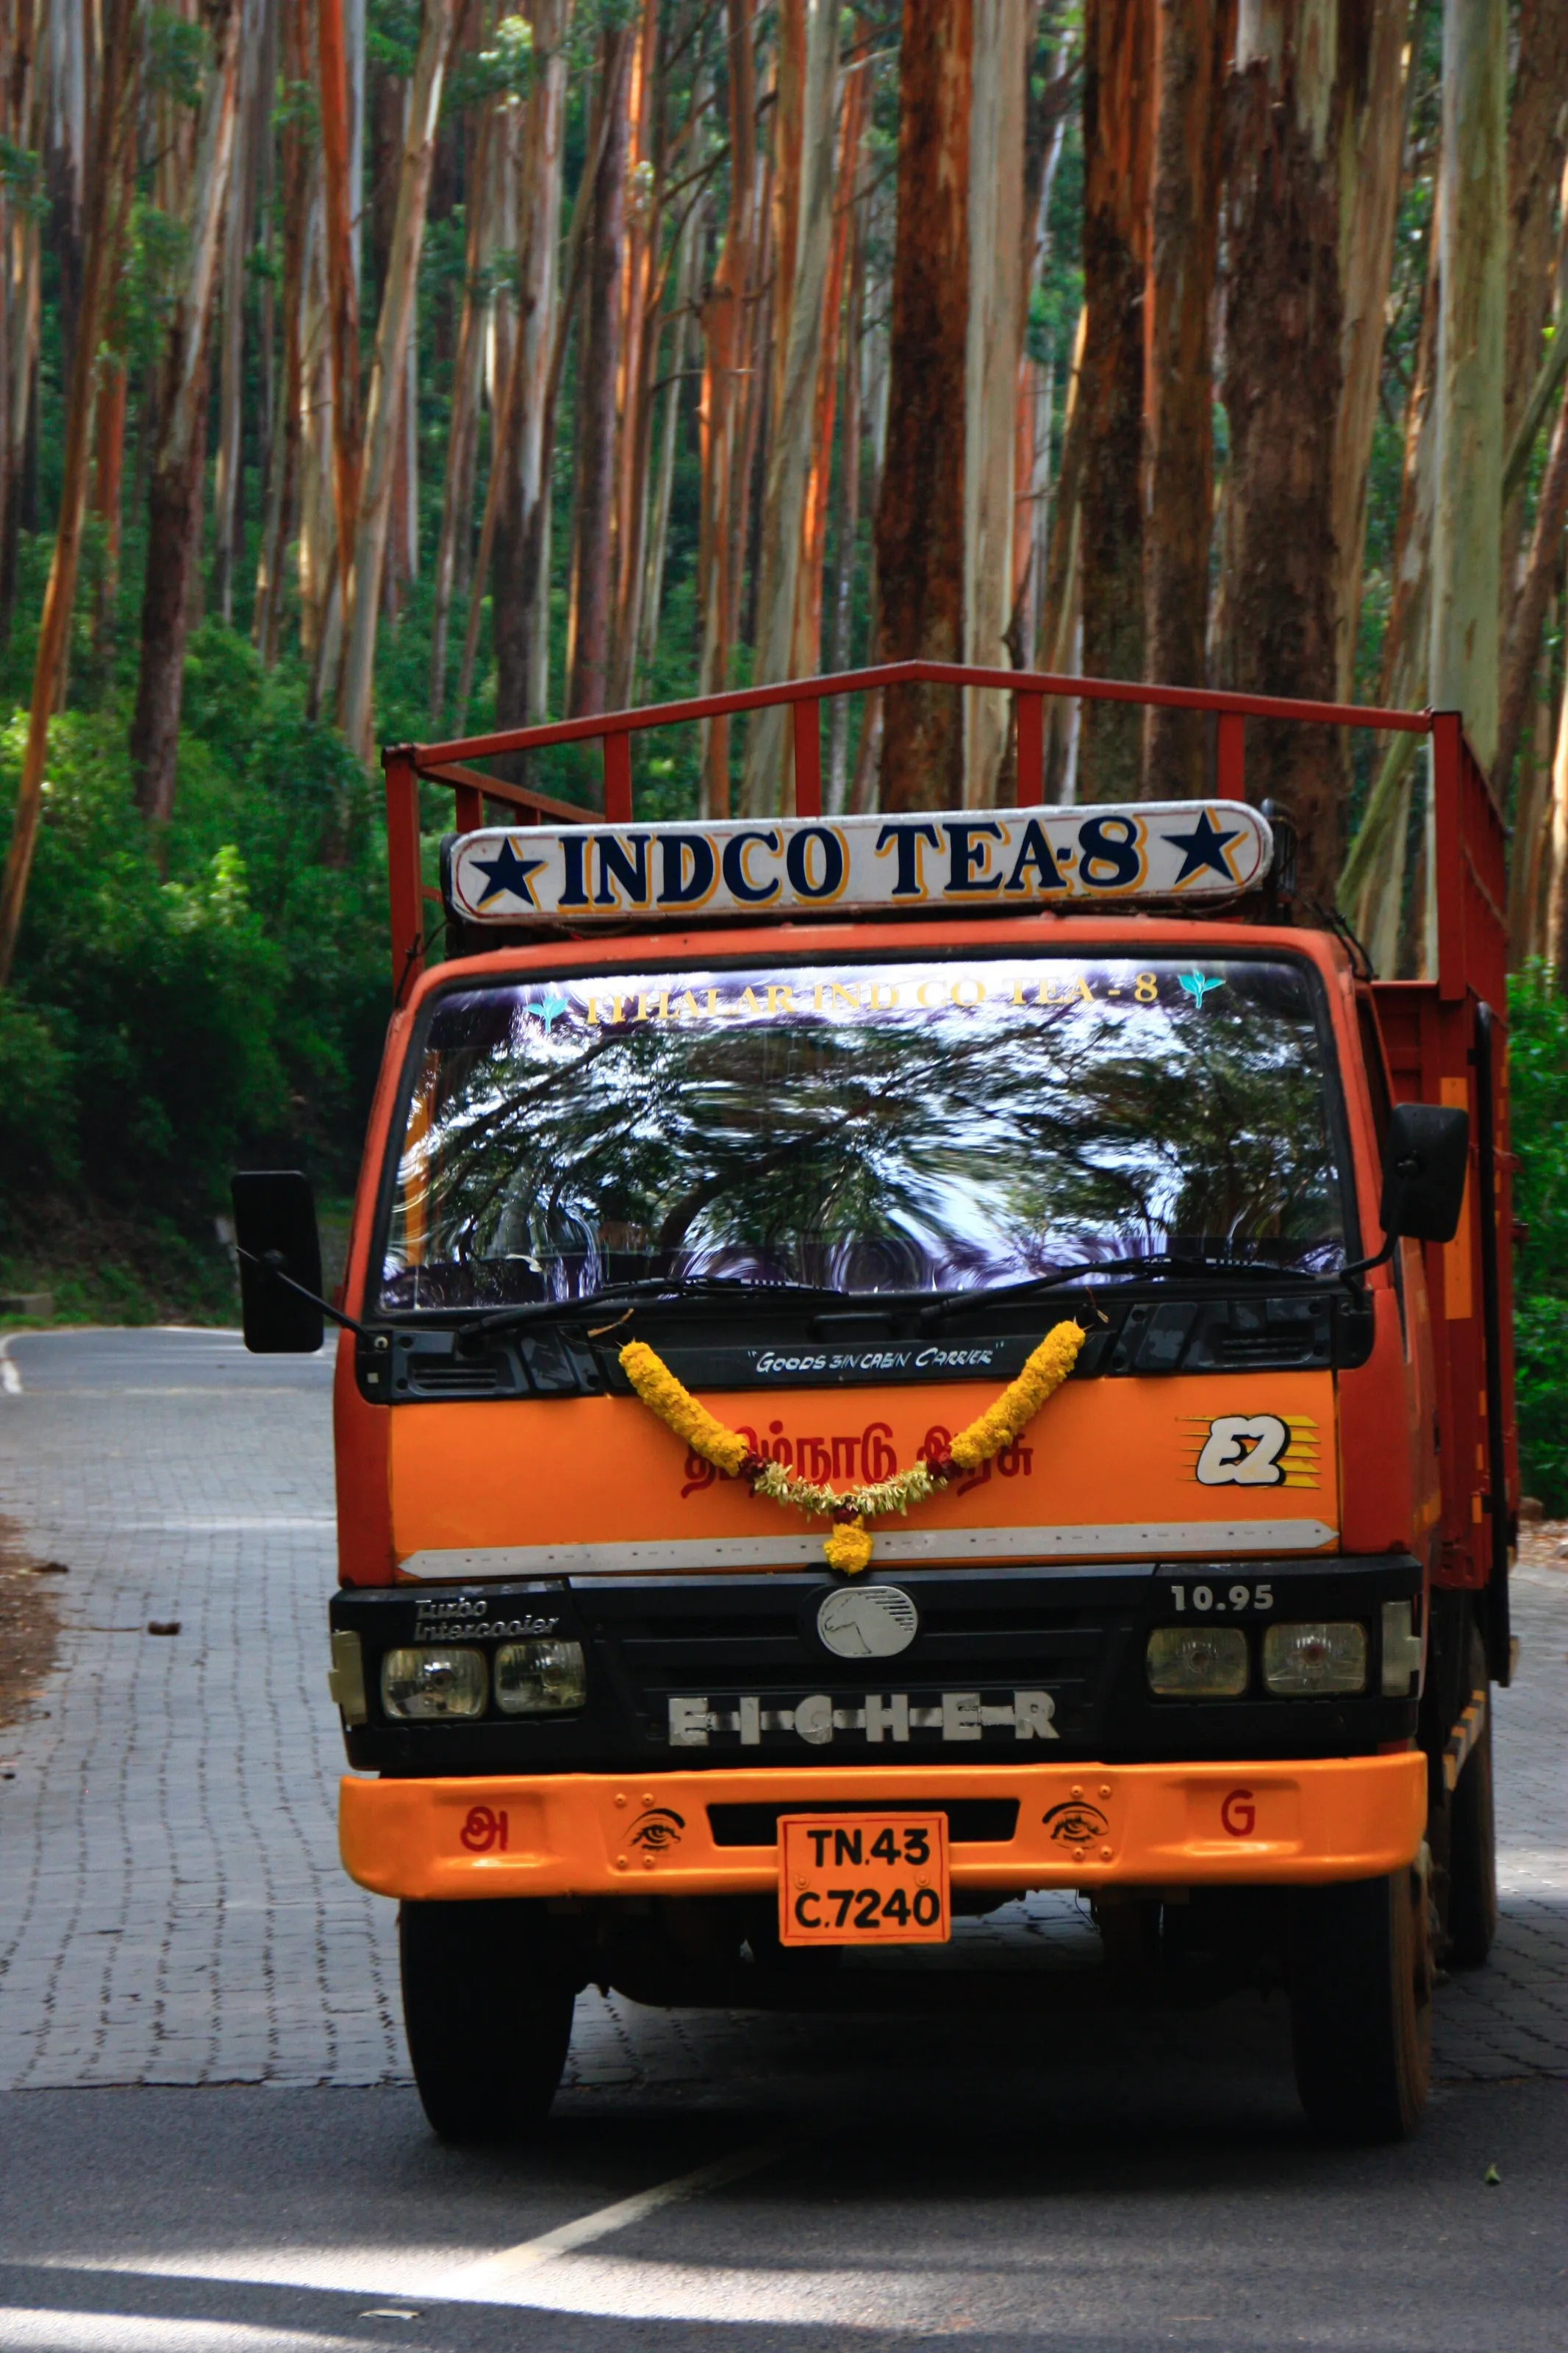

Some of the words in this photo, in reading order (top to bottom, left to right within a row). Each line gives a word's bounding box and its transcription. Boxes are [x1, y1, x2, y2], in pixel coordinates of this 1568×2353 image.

[556, 826, 850, 914] INDCO
[875, 815, 1148, 904] TEA-8
[813, 982, 900, 1010] IND
[917, 978, 987, 1007] CO
[415, 1597, 487, 1621] Turbo
[1171, 1584, 1275, 1612] 10.95
[414, 1615, 559, 1641] Intercooler
[667, 1690, 1060, 1746] EICHER
[1221, 1789, 1256, 1837] G
[806, 1828, 930, 1868] TN.43
[795, 1888, 940, 1928] C.7240
